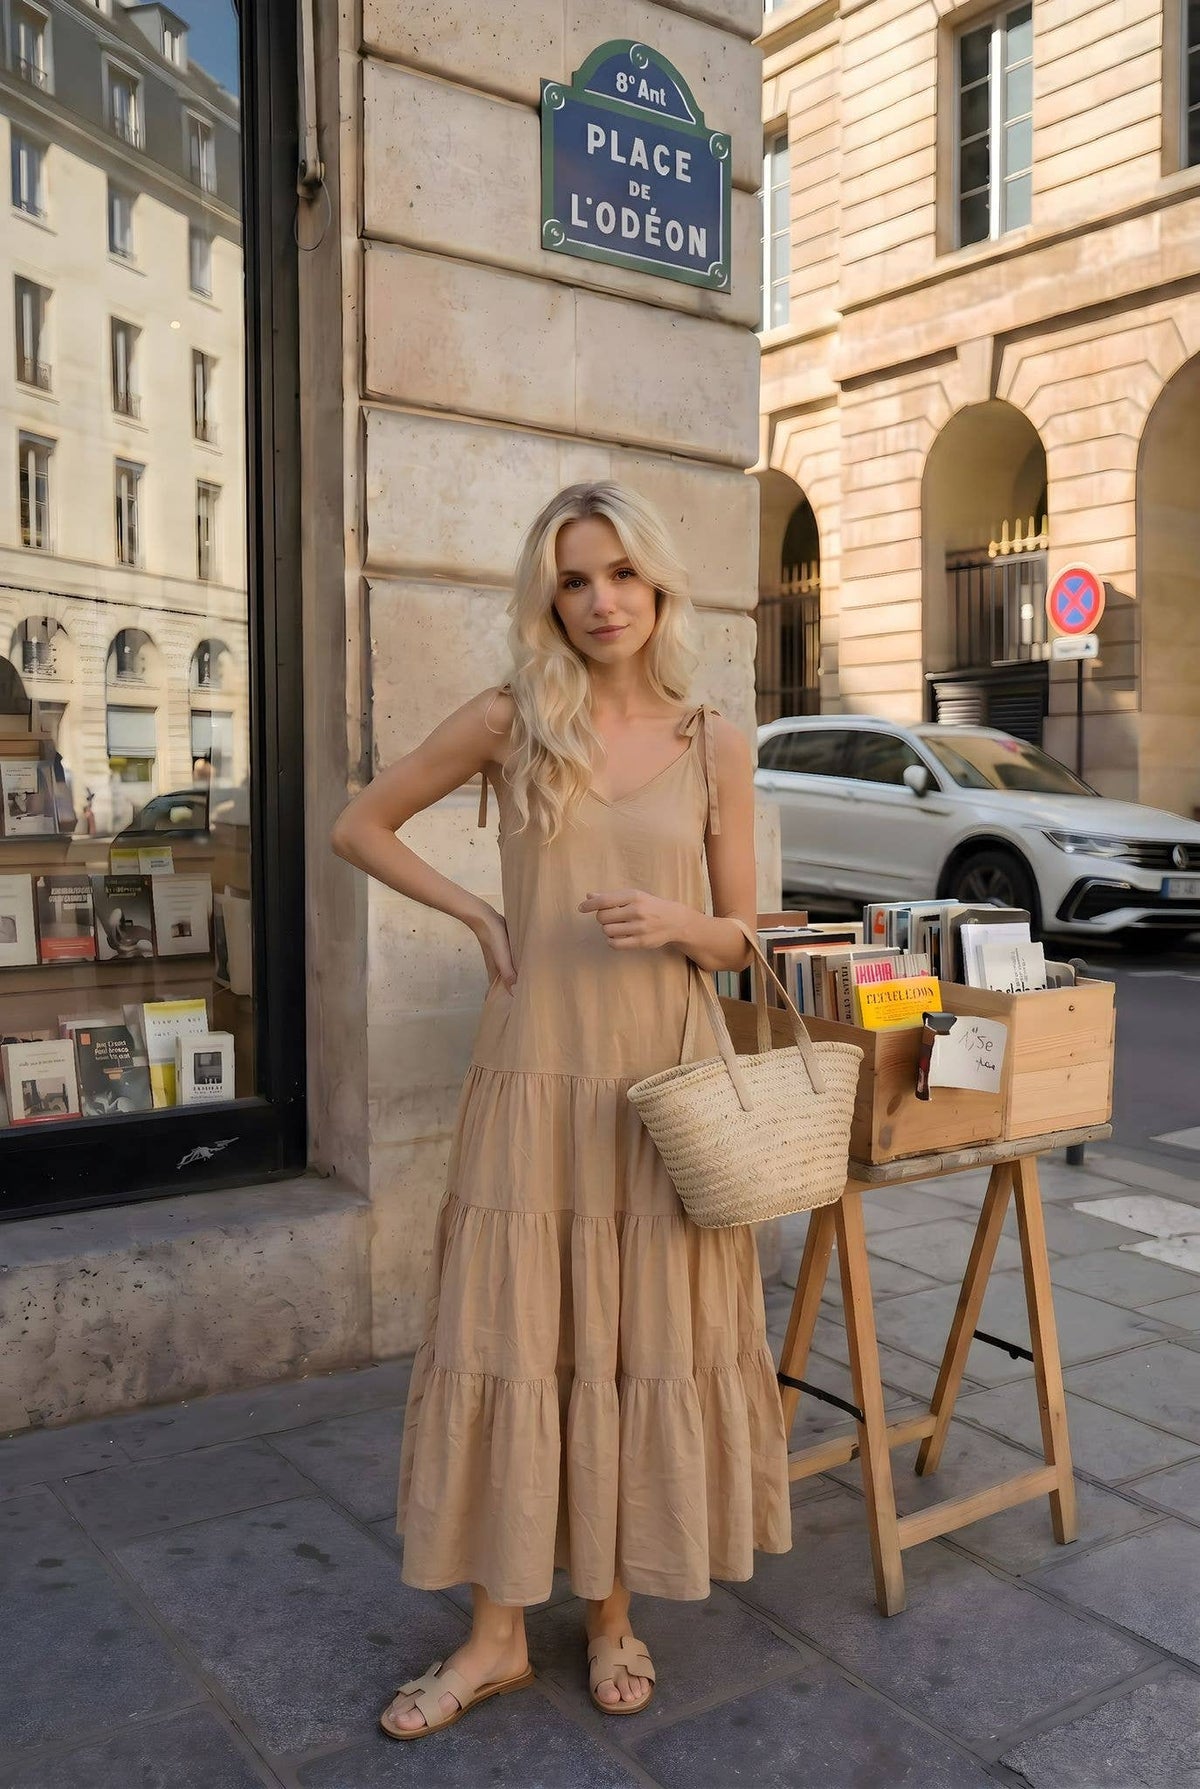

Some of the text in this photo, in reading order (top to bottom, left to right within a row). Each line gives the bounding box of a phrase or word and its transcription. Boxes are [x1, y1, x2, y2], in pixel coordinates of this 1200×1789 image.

[638, 78, 667, 107] Ant
[587, 122, 692, 183] PLACE
[629, 180, 651, 201] DE
[571, 193, 707, 259] L'ODÉON
